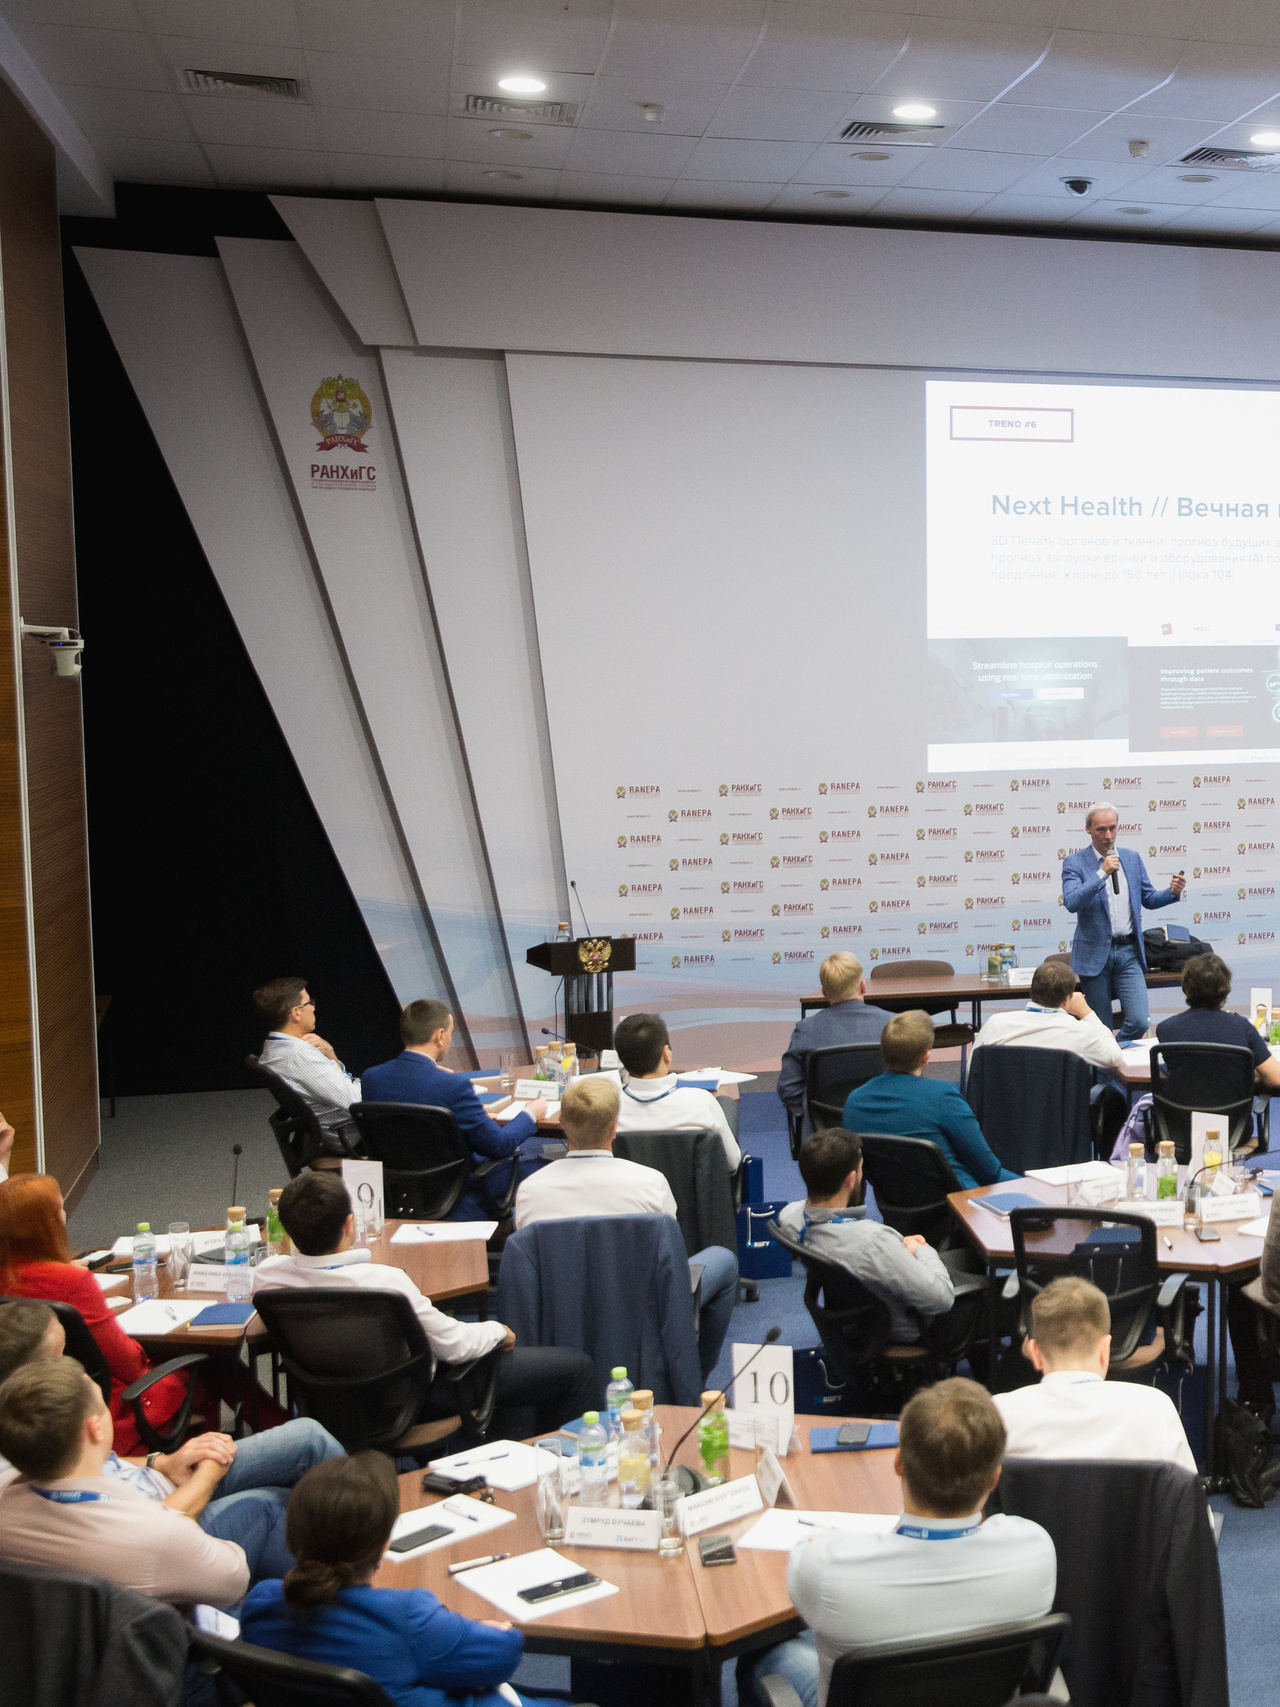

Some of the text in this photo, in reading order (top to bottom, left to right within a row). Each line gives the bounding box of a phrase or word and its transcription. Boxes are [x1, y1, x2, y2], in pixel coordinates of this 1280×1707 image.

[988, 419, 1037, 429] TREND #6
[310, 463, 377, 481] РАНХиГС
[991, 494, 1052, 516] Next
[1060, 495, 1143, 517] Health
[1150, 496, 1169, 518] //
[1177, 497, 1269, 518] Вечная
[991, 535, 1008, 546] 3D
[1012, 535, 1056, 547] Печать
[1058, 537, 1109, 549] органов
[1112, 538, 1120, 546] и
[1124, 536, 1167, 548] тканей,
[1170, 537, 1219, 549] прогноз
[1221, 537, 1271, 549] будущих
[991, 553, 1042, 565] прогноз
[1046, 553, 1100, 565] загрузки
[1104, 552, 1147, 565] врачей
[1151, 553, 1158, 563] и
[1161, 552, 1246, 565] оборудования
[1248, 553, 1263, 565] (AI
[991, 570, 1059, 582] продление
[1063, 570, 1101, 580] жизни
[1104, 570, 1119, 582] до
[1122, 569, 1143, 580] 150
[1145, 570, 1165, 580] лет
[1177, 570, 1209, 582] (пока
[1212, 569, 1236, 582] 104)
[972, 659, 1099, 671] Streamline hospital operations
[1160, 667, 1195, 676] Improving
[1196, 667, 1220, 675] patient
[978, 671, 1094, 683] using real time optimization
[1160, 675, 1205, 684] through data
[1021, 778, 1051, 787] RANEPA
[1113, 777, 1142, 786] РАНХиГС
[1203, 775, 1231, 784] RANEPA
[628, 785, 661, 794] RANEPA
[732, 784, 762, 792] РАНХиГС
[830, 782, 861, 791] RANEPA
[928, 781, 956, 789] РАНХиГС
[1068, 801, 1096, 809] RANEP
[1159, 799, 1187, 808] РАНХиГС
[1247, 797, 1275, 805] RANEPA
[782, 807, 812, 816] РАНХиГС
[880, 805, 909, 813] RANEPA
[975, 803, 1005, 812] РАНХиГС
[681, 809, 711, 817] RANEPA
[1203, 820, 1231, 829] RANEPA
[832, 830, 861, 838] RANEPA
[928, 827, 958, 836] РАНХиГС
[1022, 825, 1051, 834] RANEPA
[630, 834, 662, 843] RANEPA
[733, 833, 763, 841] РАНХиГС
[1159, 844, 1187, 853] РАНХиГС
[1248, 842, 1275, 851] RANEPA
[880, 852, 910, 861] RANEPA
[976, 850, 1004, 858] РАНХиГС
[682, 858, 712, 866] RANEPA
[783, 855, 813, 864] РАНХиГС
[1203, 866, 1231, 874] RANEPA
[928, 874, 958, 883] РАНХиГС
[1022, 871, 1052, 880] RANEPA
[734, 881, 763, 889] РАНХиГС
[832, 877, 862, 886] RANEPA
[632, 884, 662, 892] RANEPA
[1248, 887, 1276, 896] RANEPA
[880, 899, 911, 908] RANEPA
[976, 896, 1006, 905] РАНХиГС
[682, 906, 715, 915] RANEPA
[784, 903, 813, 912] РАНХиГС
[1203, 911, 1232, 920] RANEPA
[930, 922, 958, 930] РАНХиГС
[1023, 918, 1052, 927] RANEPA
[734, 929, 764, 938] РАНХиГС
[832, 925, 863, 934] RANEPA
[1248, 931, 1276, 940] RANEPA
[785, 951, 814, 959] РАНХиГС
[881, 946, 912, 955] RANEPA
[684, 955, 714, 963] RANEPA
[357, 1182, 376, 1210] 9
[749, 1370, 791, 1406] 10
